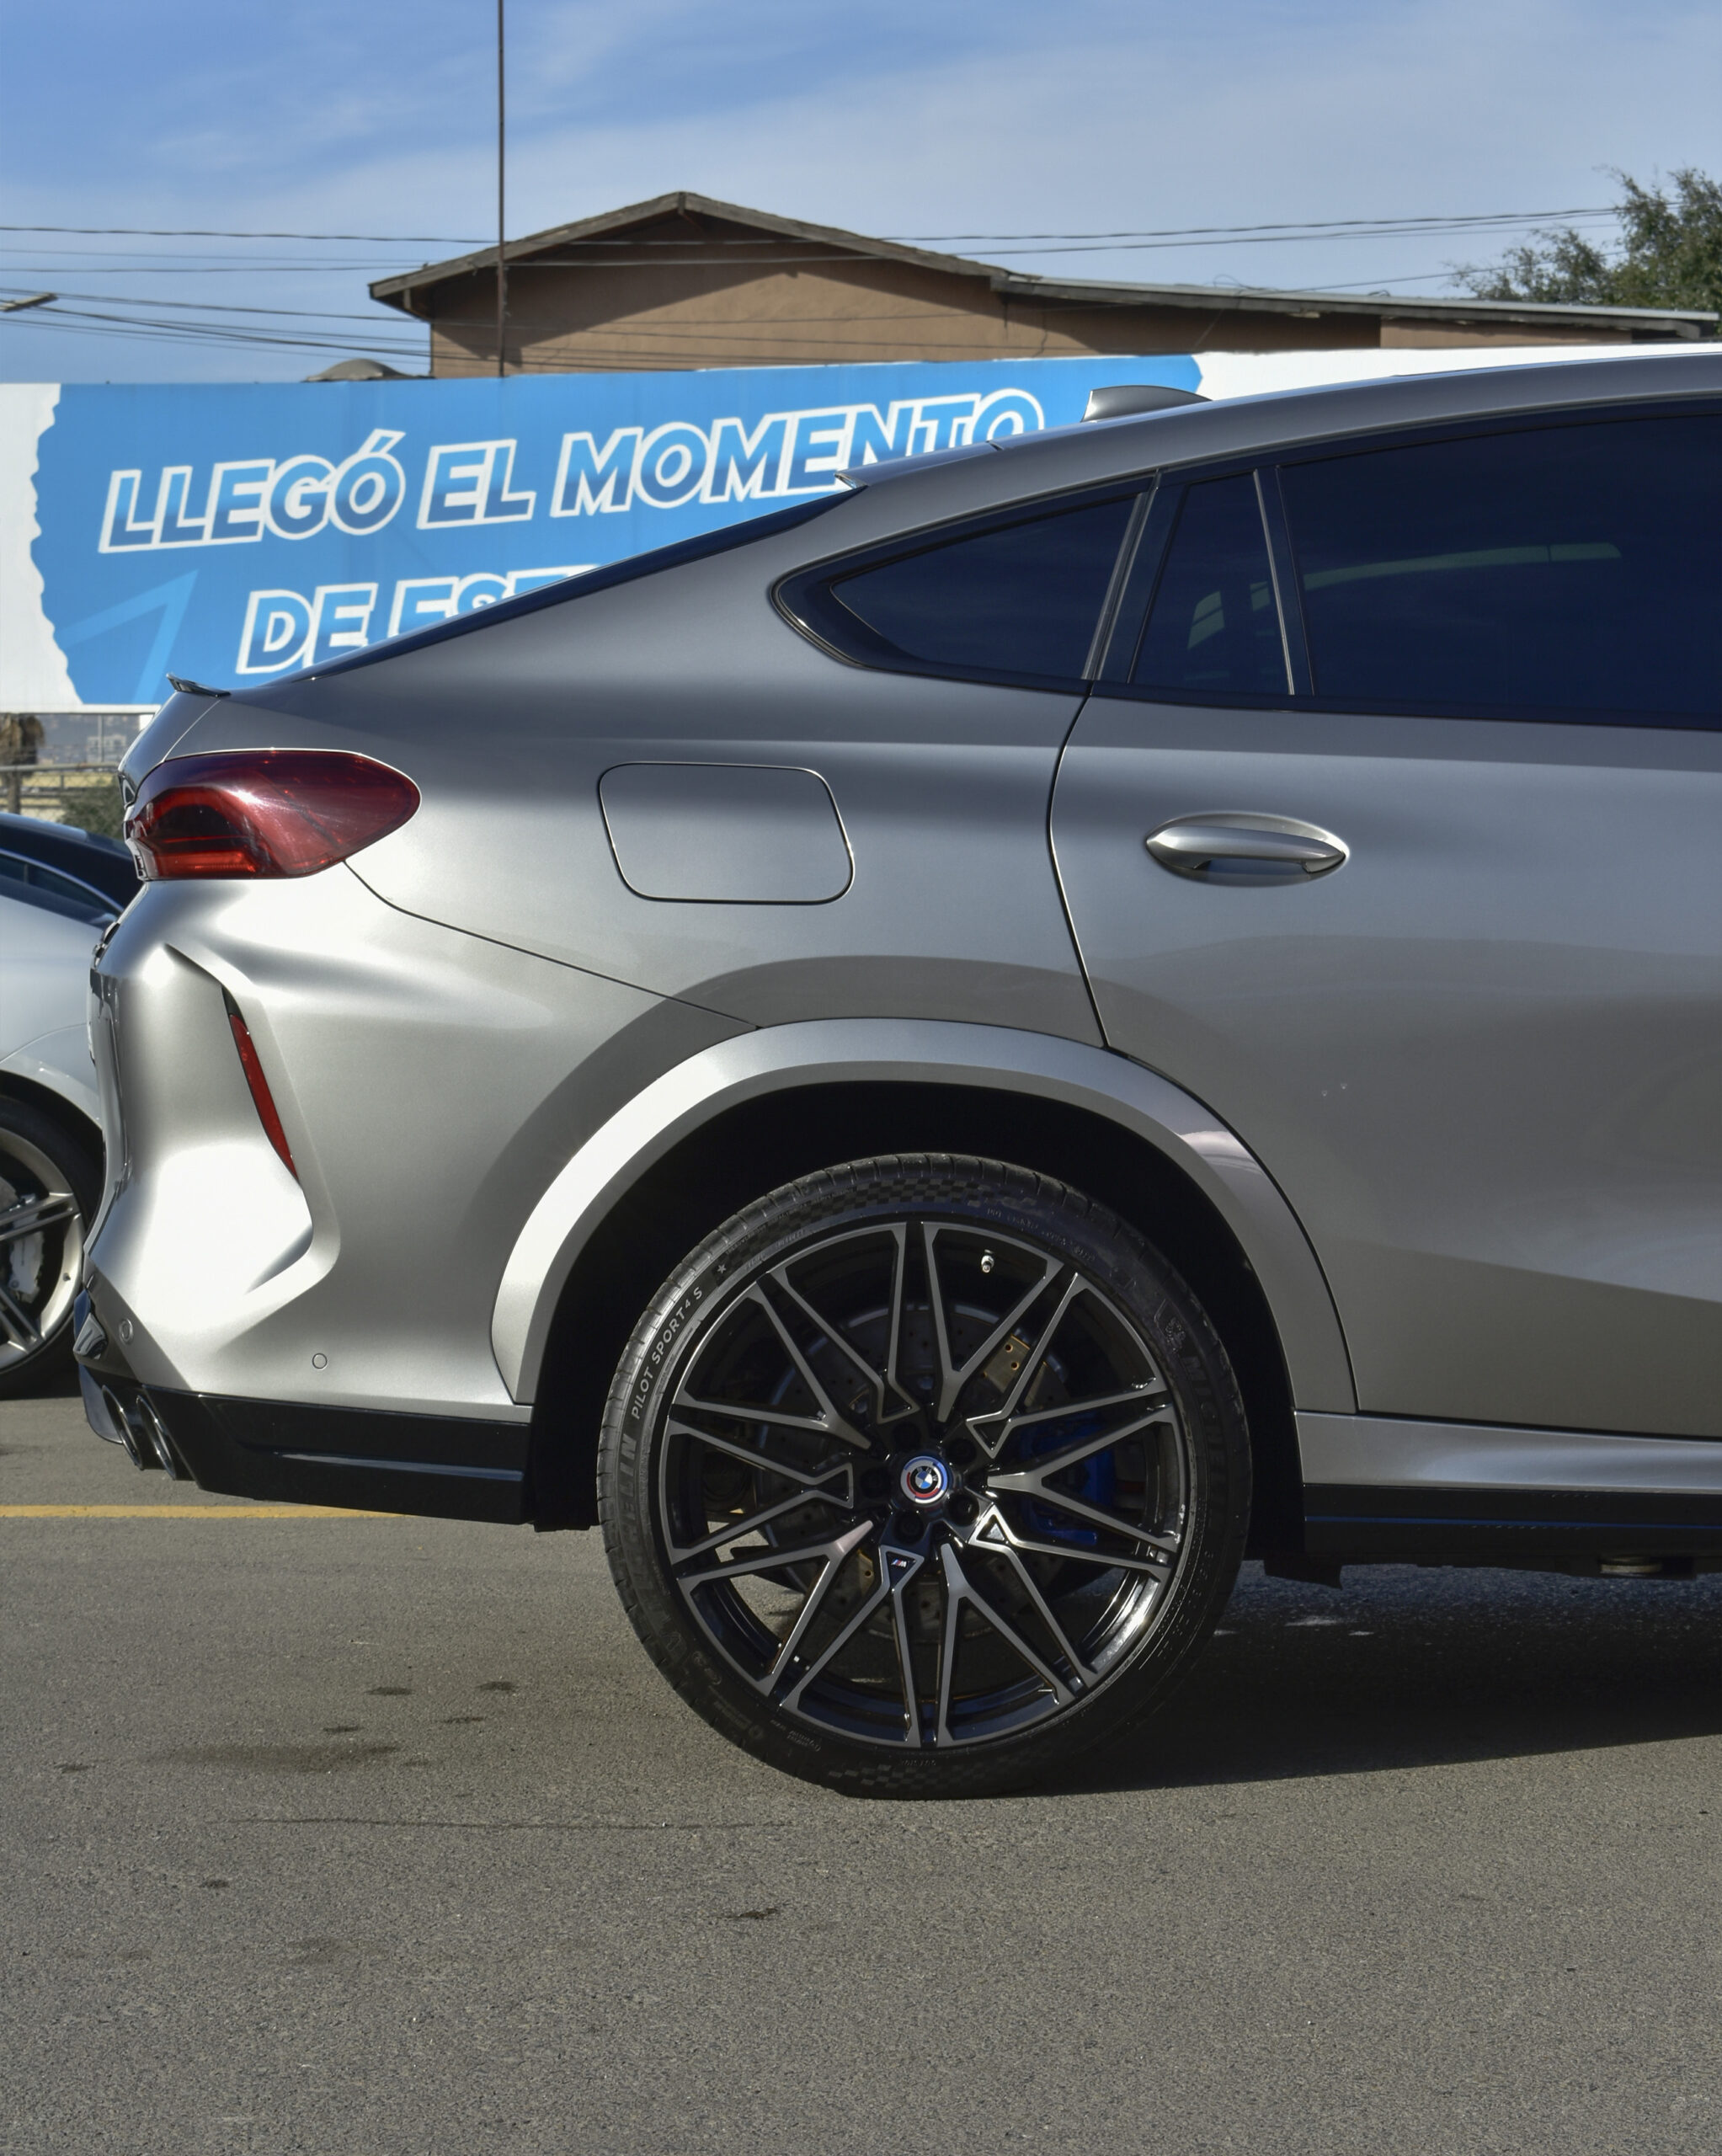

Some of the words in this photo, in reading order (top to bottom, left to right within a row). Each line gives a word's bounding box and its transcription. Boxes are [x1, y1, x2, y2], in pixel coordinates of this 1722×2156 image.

[98, 429, 407, 554] LLEGÓ
[417, 439, 537, 530] EL
[550, 388, 1045, 518] MOMENTO
[236, 583, 379, 675] DE
[632, 1366, 653, 1420] PILOT
[652, 1306, 686, 1364] SPORT
